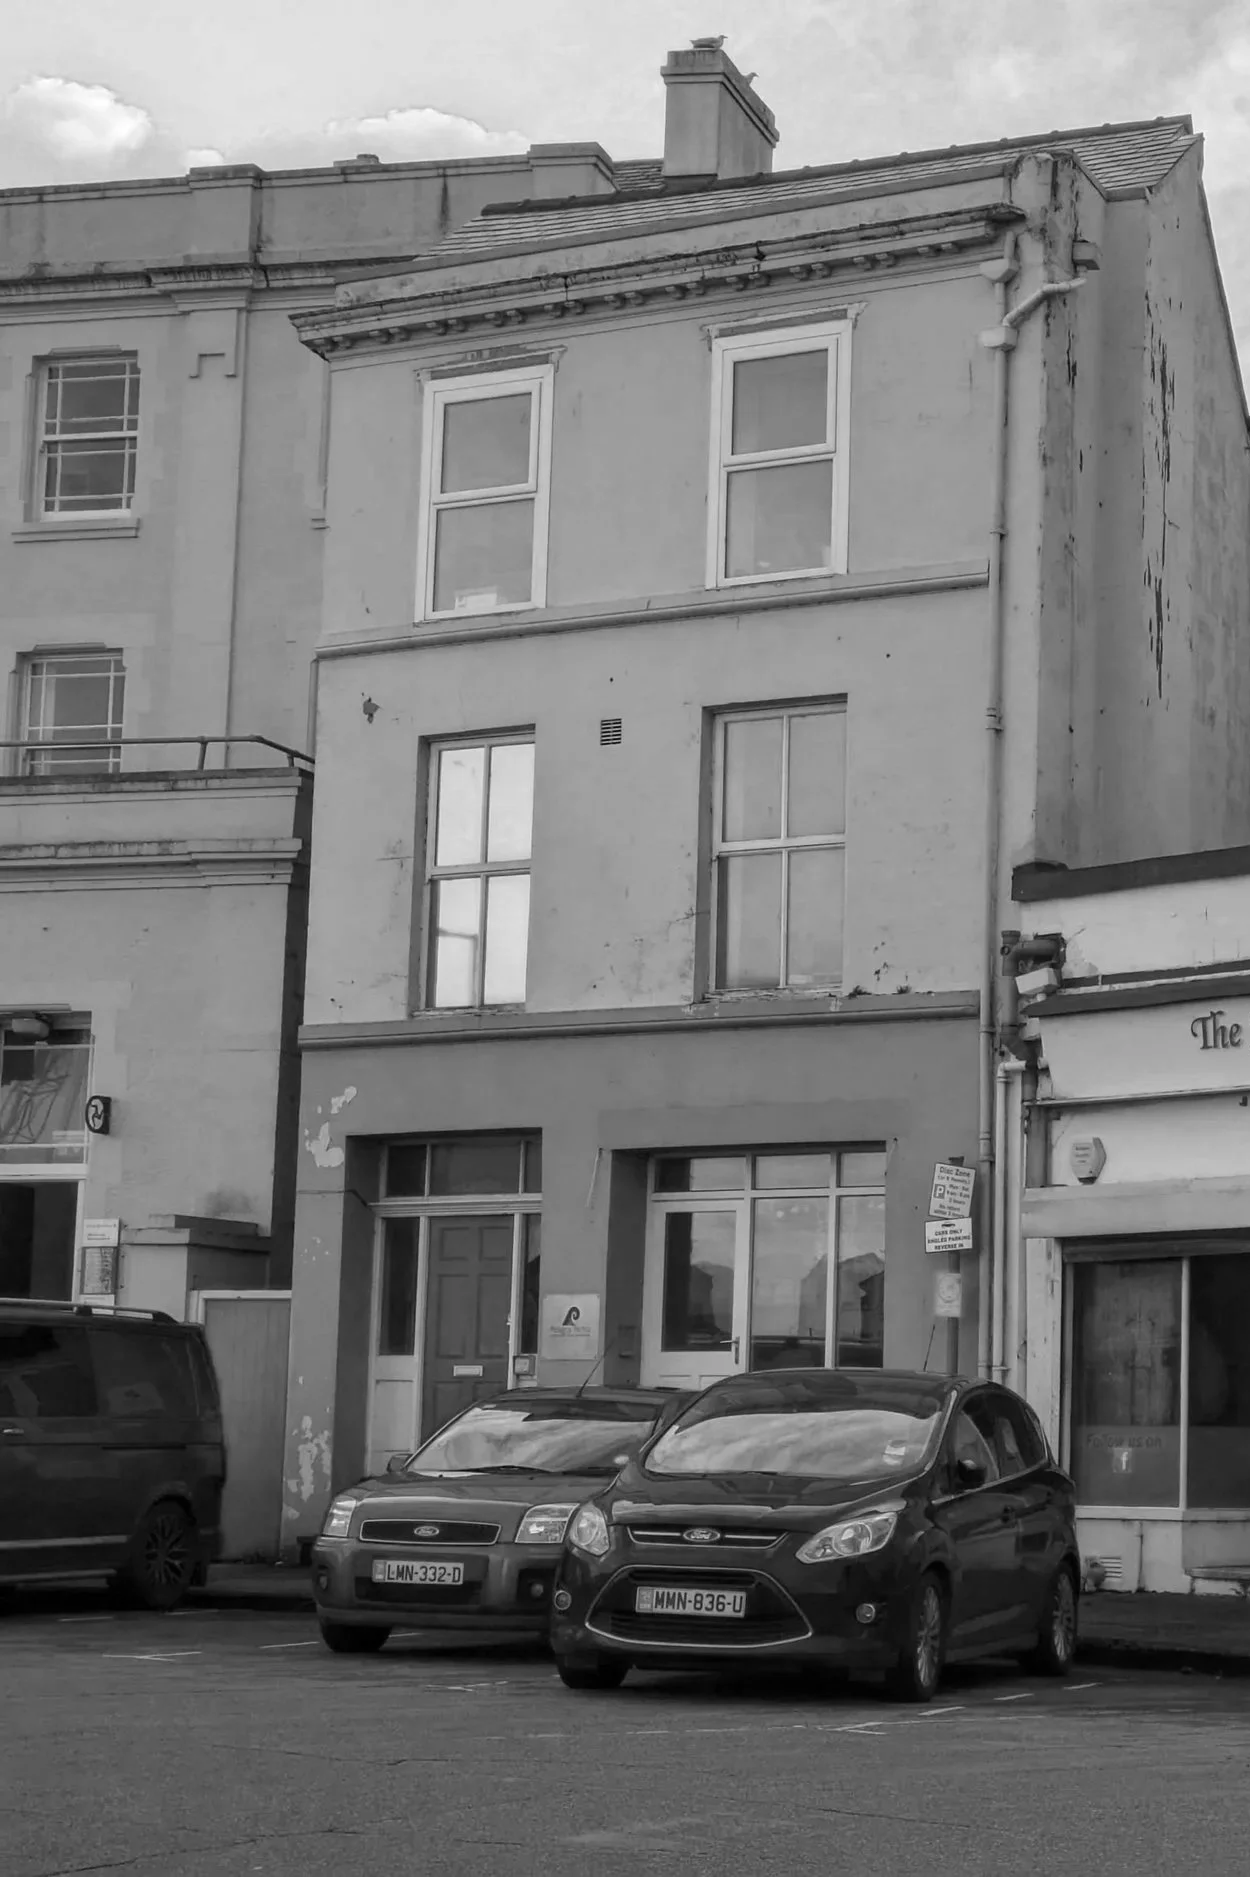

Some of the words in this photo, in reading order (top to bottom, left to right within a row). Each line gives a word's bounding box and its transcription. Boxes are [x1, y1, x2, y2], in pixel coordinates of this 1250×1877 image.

[1190, 1010, 1241, 1050] The
[940, 1167, 953, 1175] Disc
[956, 1169, 971, 1177] Zone
[936, 1184, 945, 1198] P
[387, 1564, 461, 1583] LMN-332-D
[654, 1591, 743, 1613] MMN-836-U
